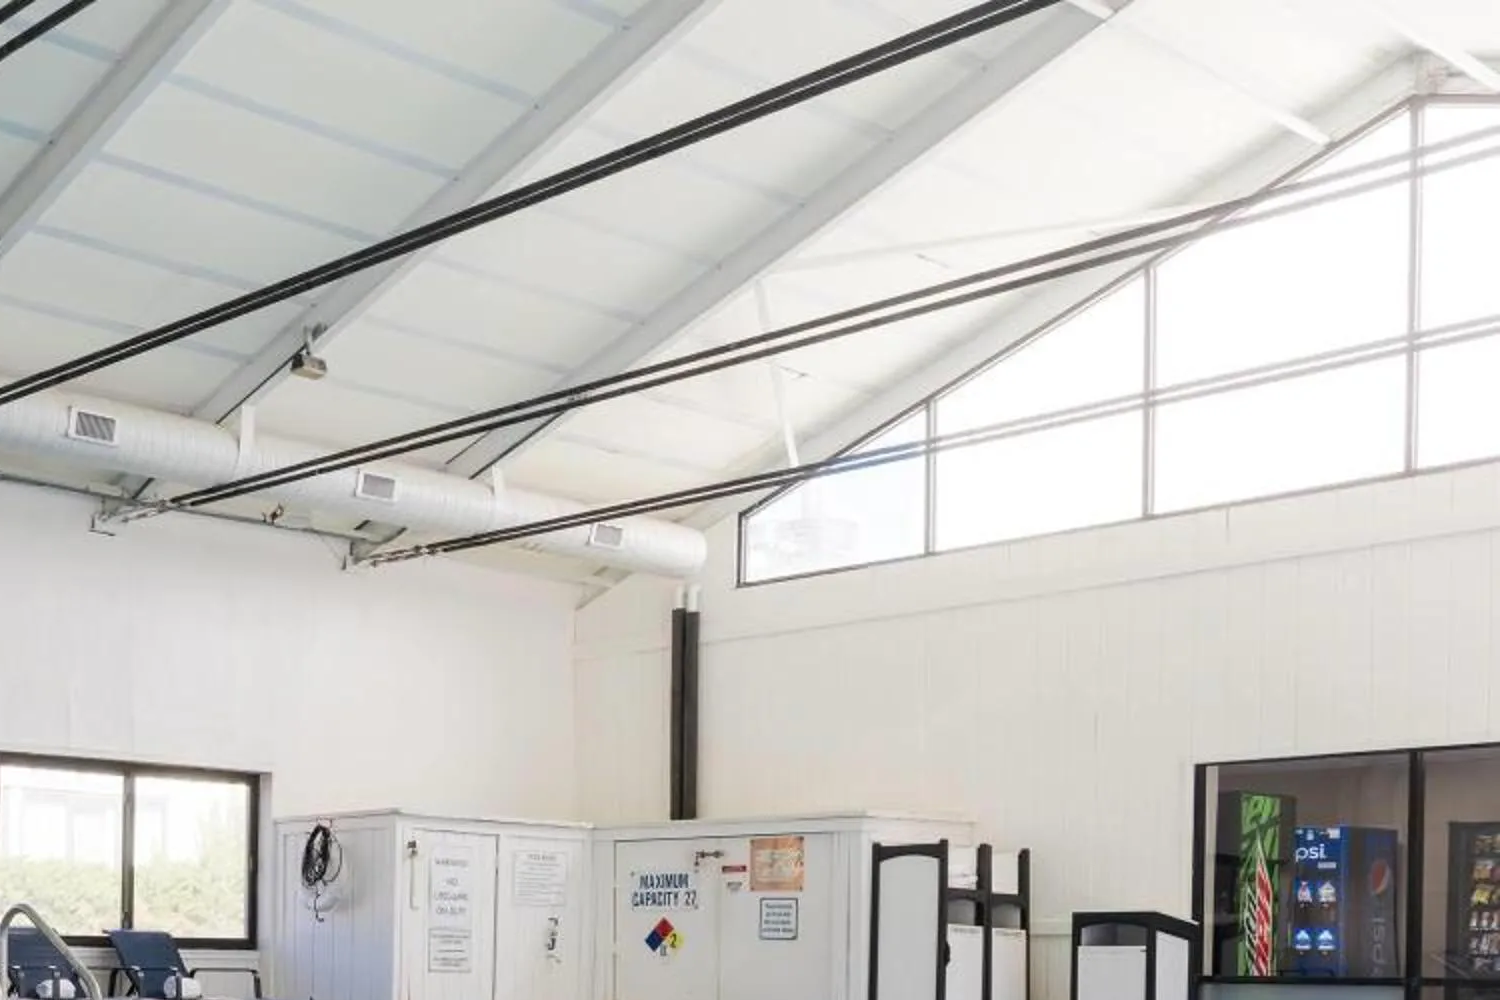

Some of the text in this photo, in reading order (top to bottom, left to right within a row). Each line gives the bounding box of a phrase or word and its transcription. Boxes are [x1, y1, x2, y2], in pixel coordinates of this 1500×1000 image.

[1295, 844, 1328, 862] psi
[640, 872, 689, 889] MAXIMUM
[632, 891, 679, 907] CAPACITY
